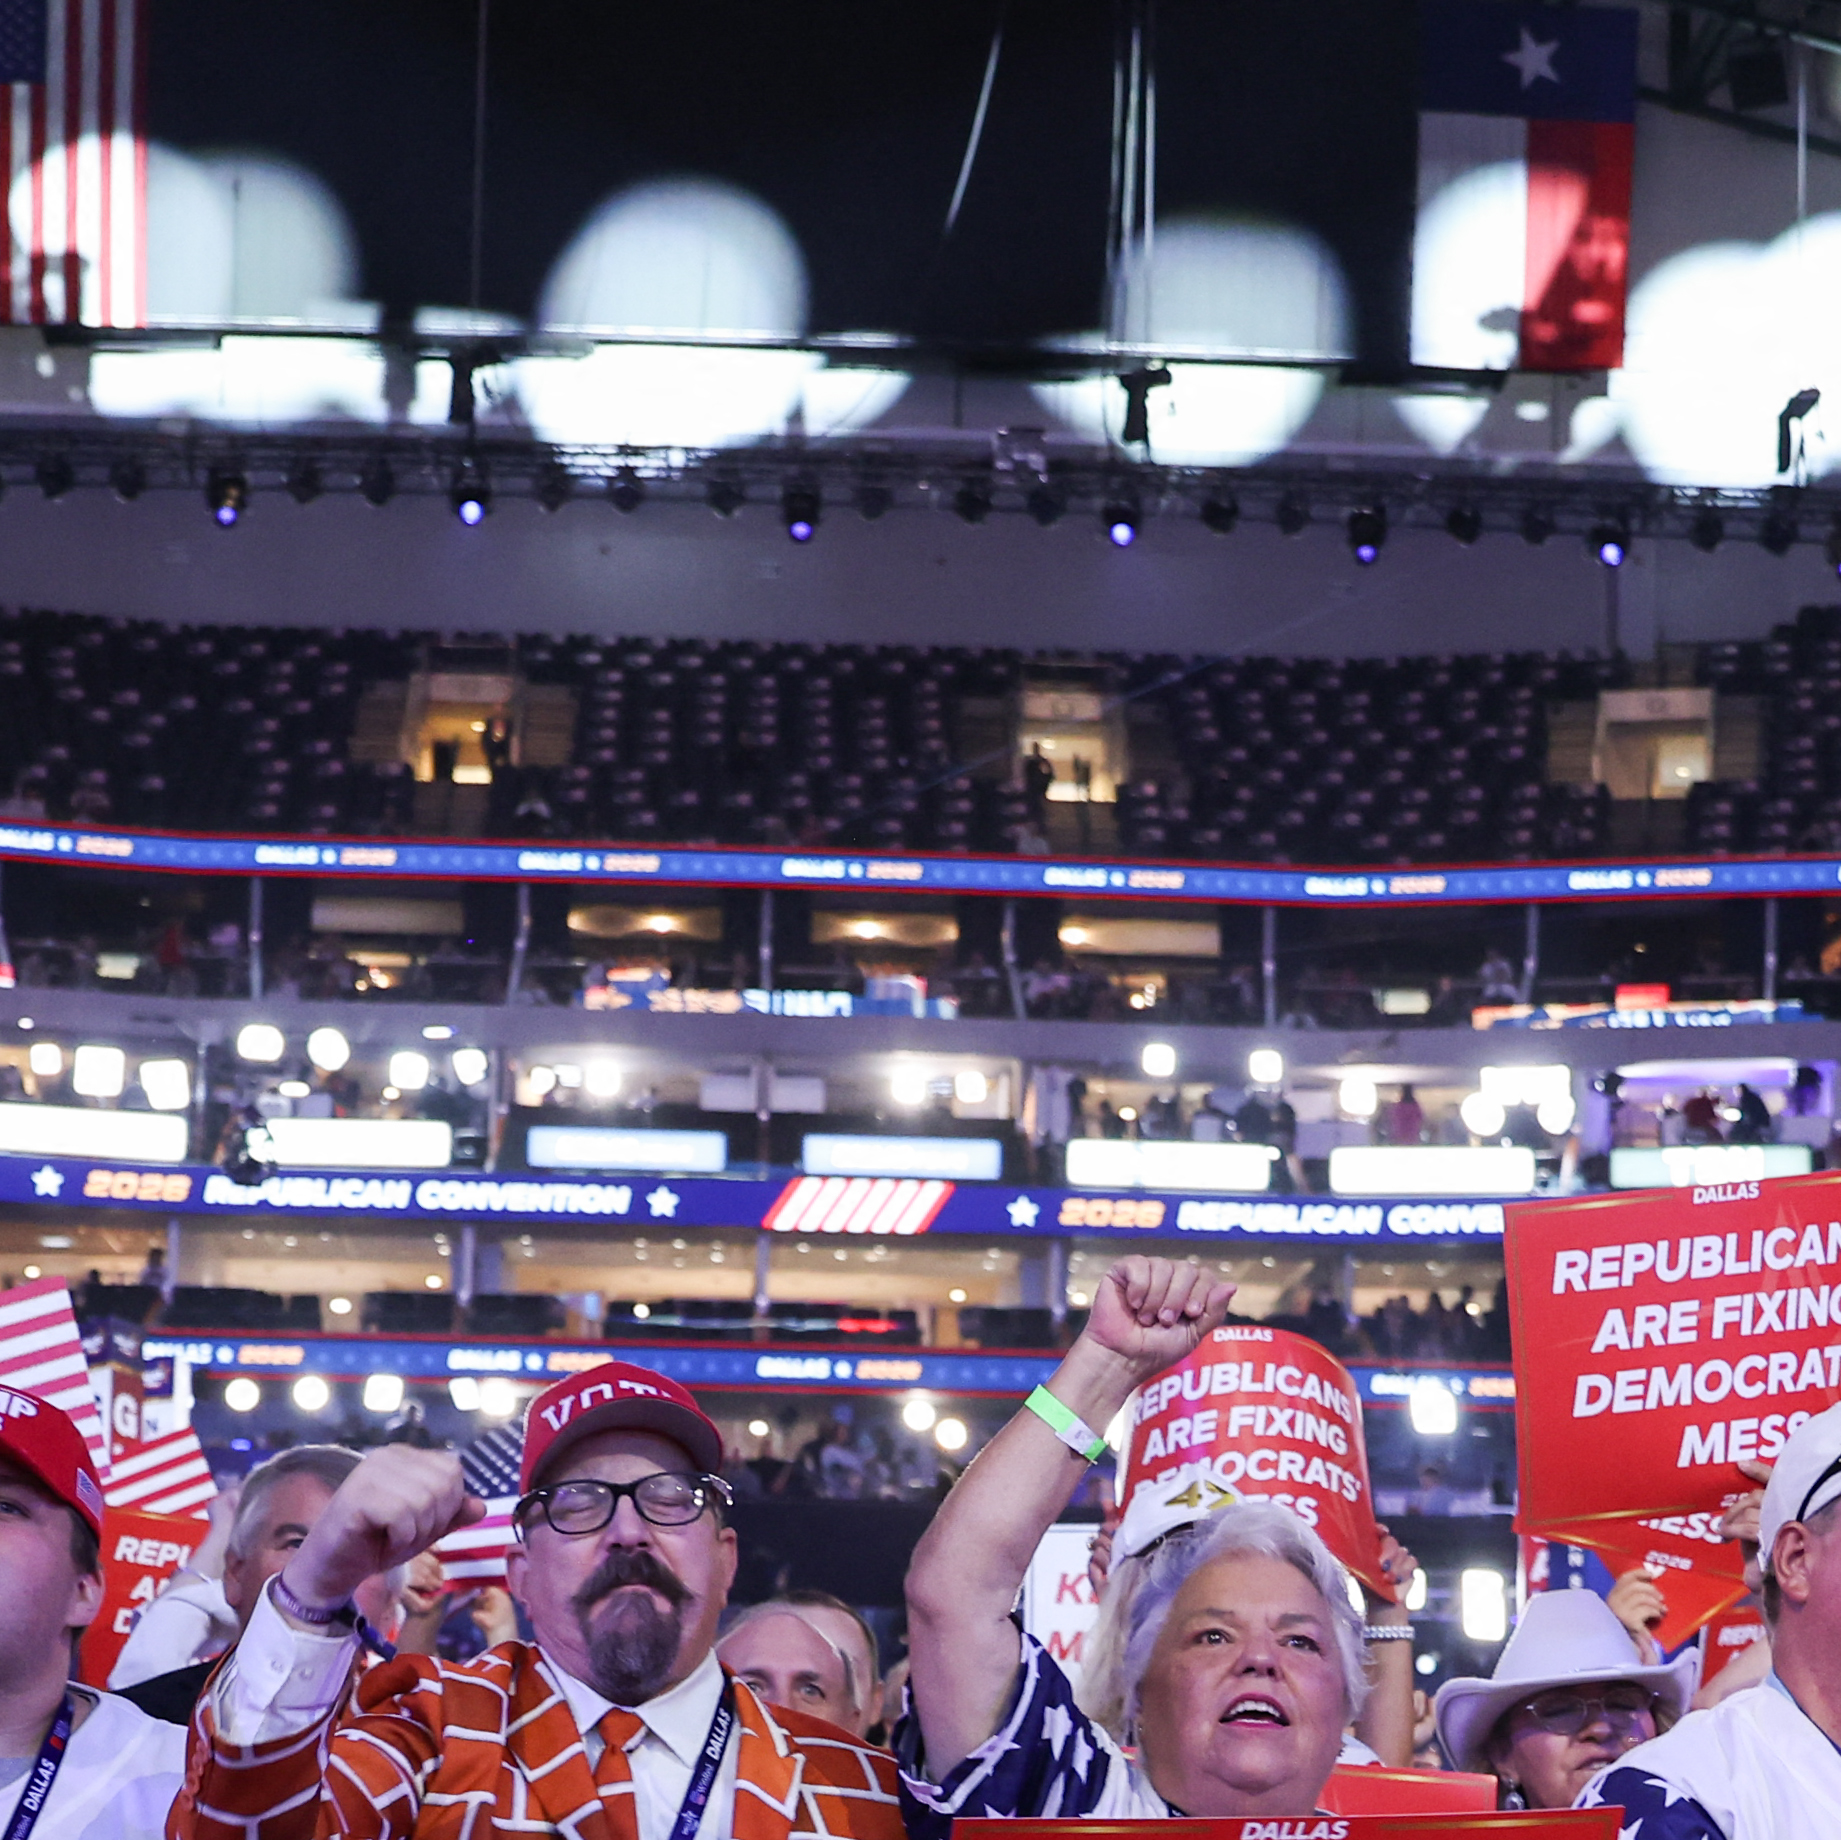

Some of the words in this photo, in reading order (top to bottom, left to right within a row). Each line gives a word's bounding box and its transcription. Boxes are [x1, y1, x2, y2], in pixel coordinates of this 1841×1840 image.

[83, 1170, 193, 1202] 2026
[415, 1180, 632, 1216] CONVENTION
[1058, 1198, 1165, 1230] 2026
[1176, 1200, 1381, 1234] REPUBLICAN
[1692, 1181, 1760, 1205] DALLAS
[1212, 1329, 1273, 1342] DALLAS
[1591, 1301, 1701, 1355] ARE
[1141, 1409, 1218, 1466] ARE
[1227, 1405, 1348, 1456] FIXING
[707, 1708, 732, 1761] DALLAS
[23, 1758, 56, 1811] DALLAS
